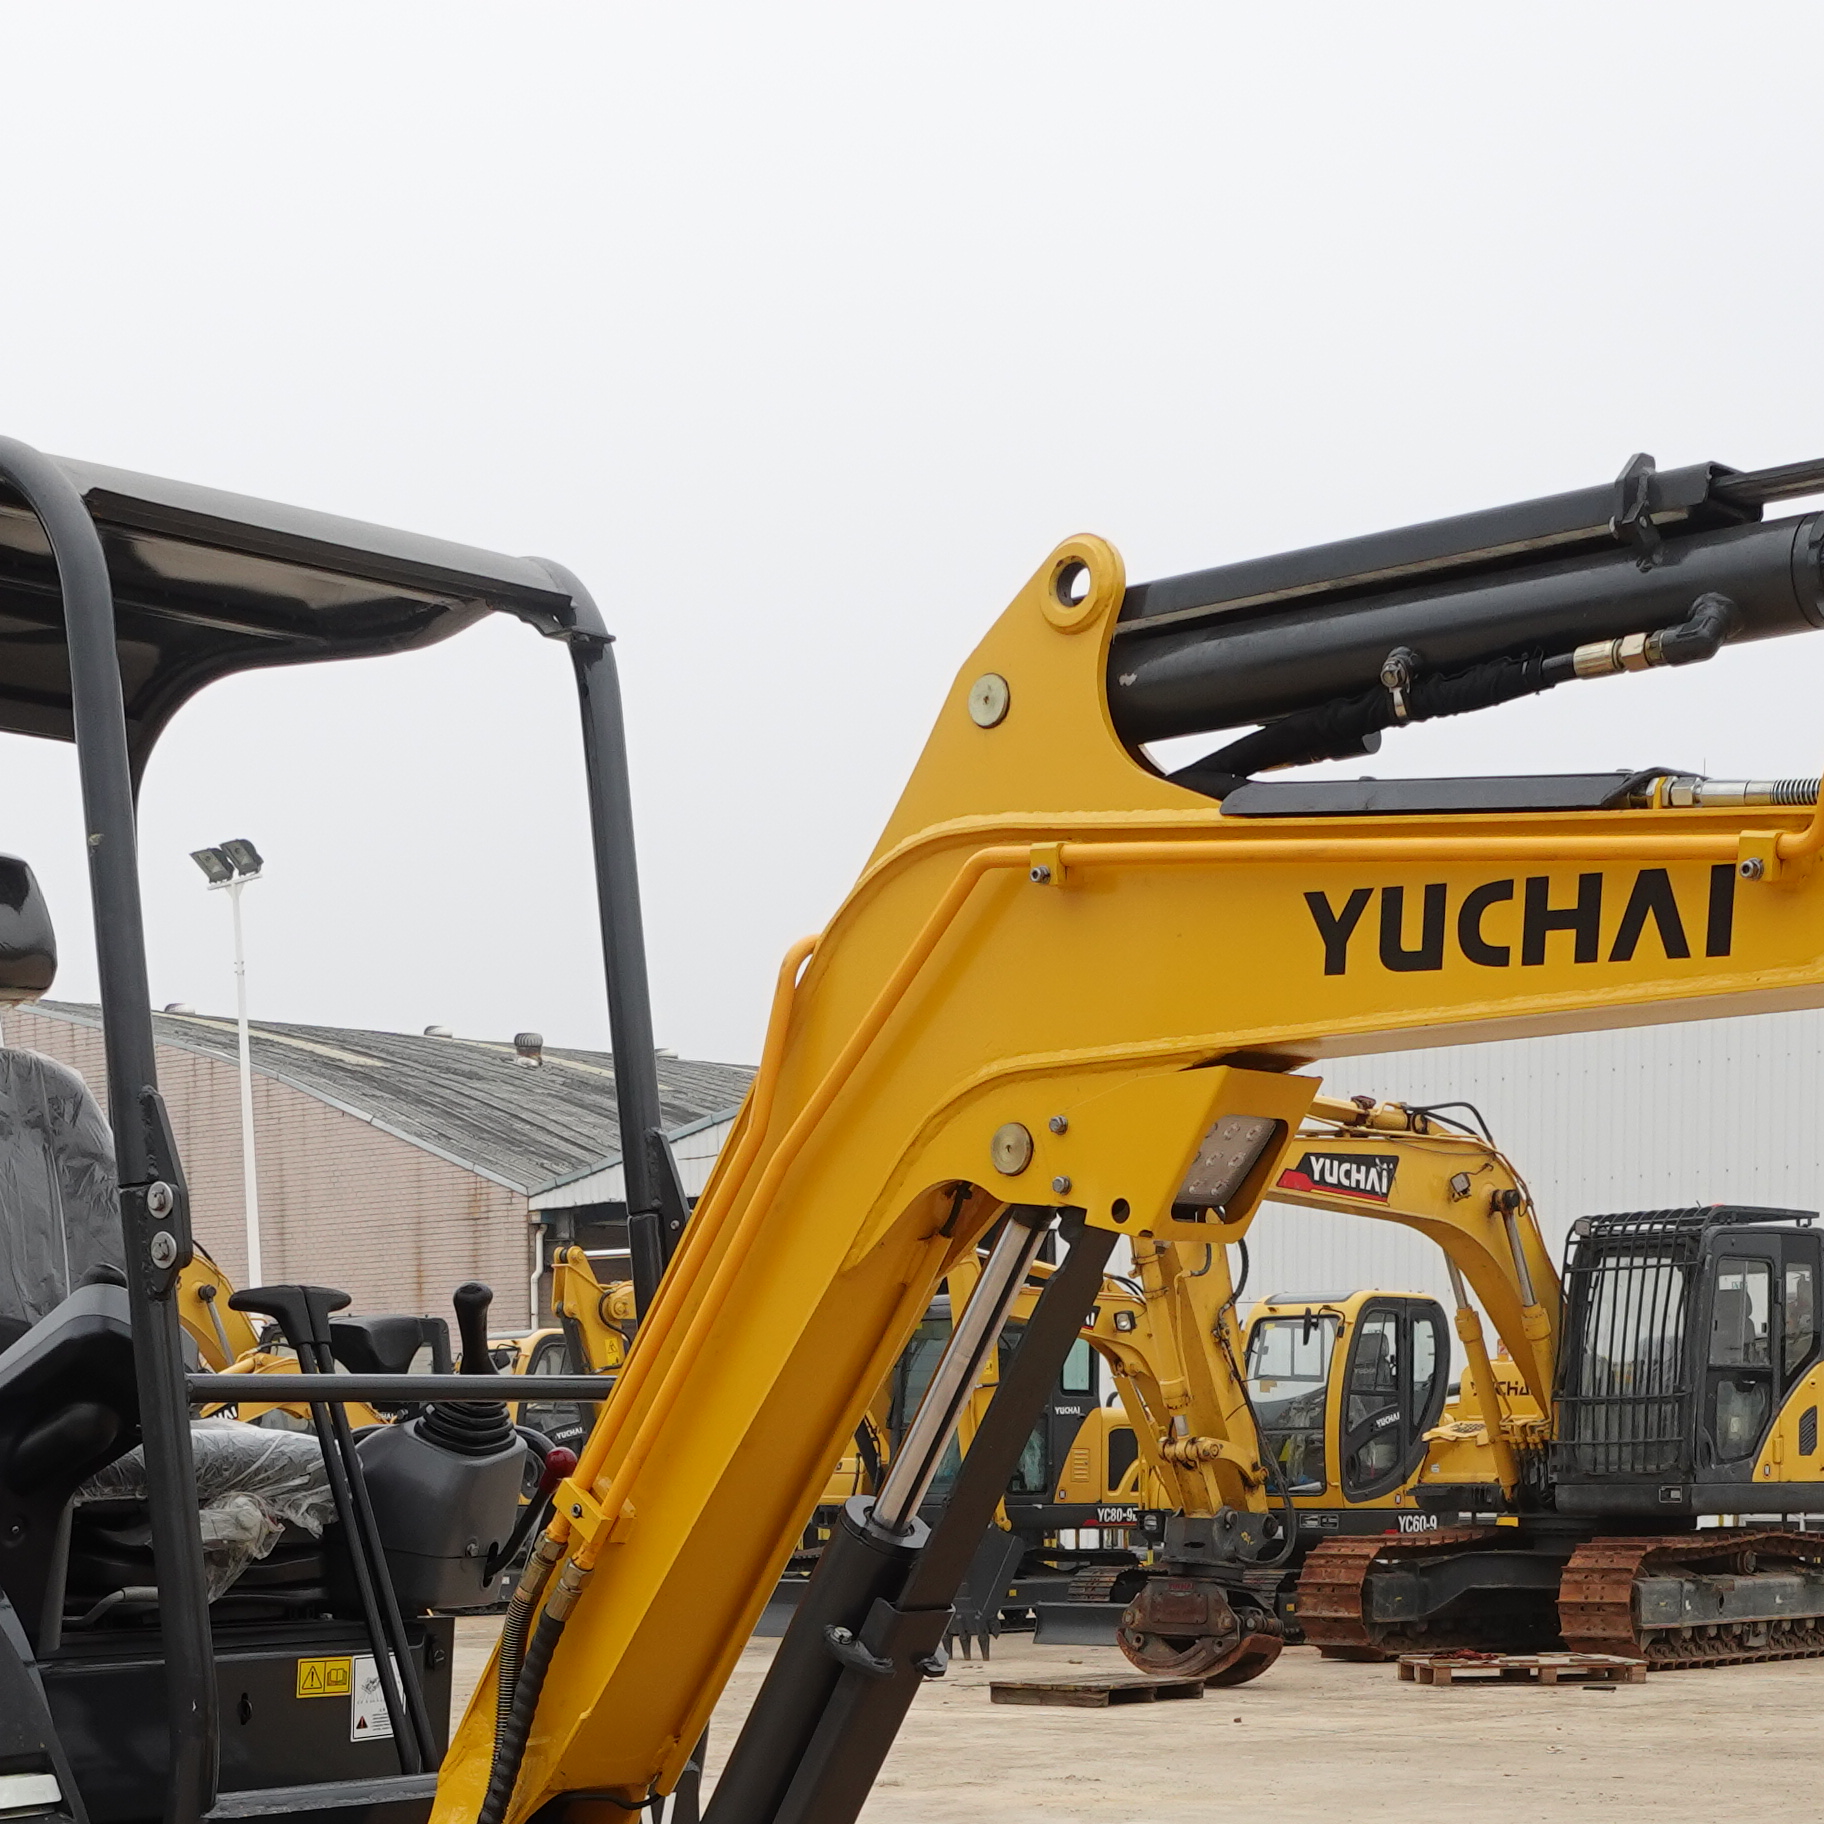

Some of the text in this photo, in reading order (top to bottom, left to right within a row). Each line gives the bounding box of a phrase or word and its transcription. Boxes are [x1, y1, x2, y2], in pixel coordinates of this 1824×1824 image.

[1303, 863, 1736, 976] YUCHAI
[1310, 1156, 1388, 1193] YUCHAI
[1055, 1406, 1080, 1415] YUCHAI
[1398, 1515, 1437, 1533] YC60-9
